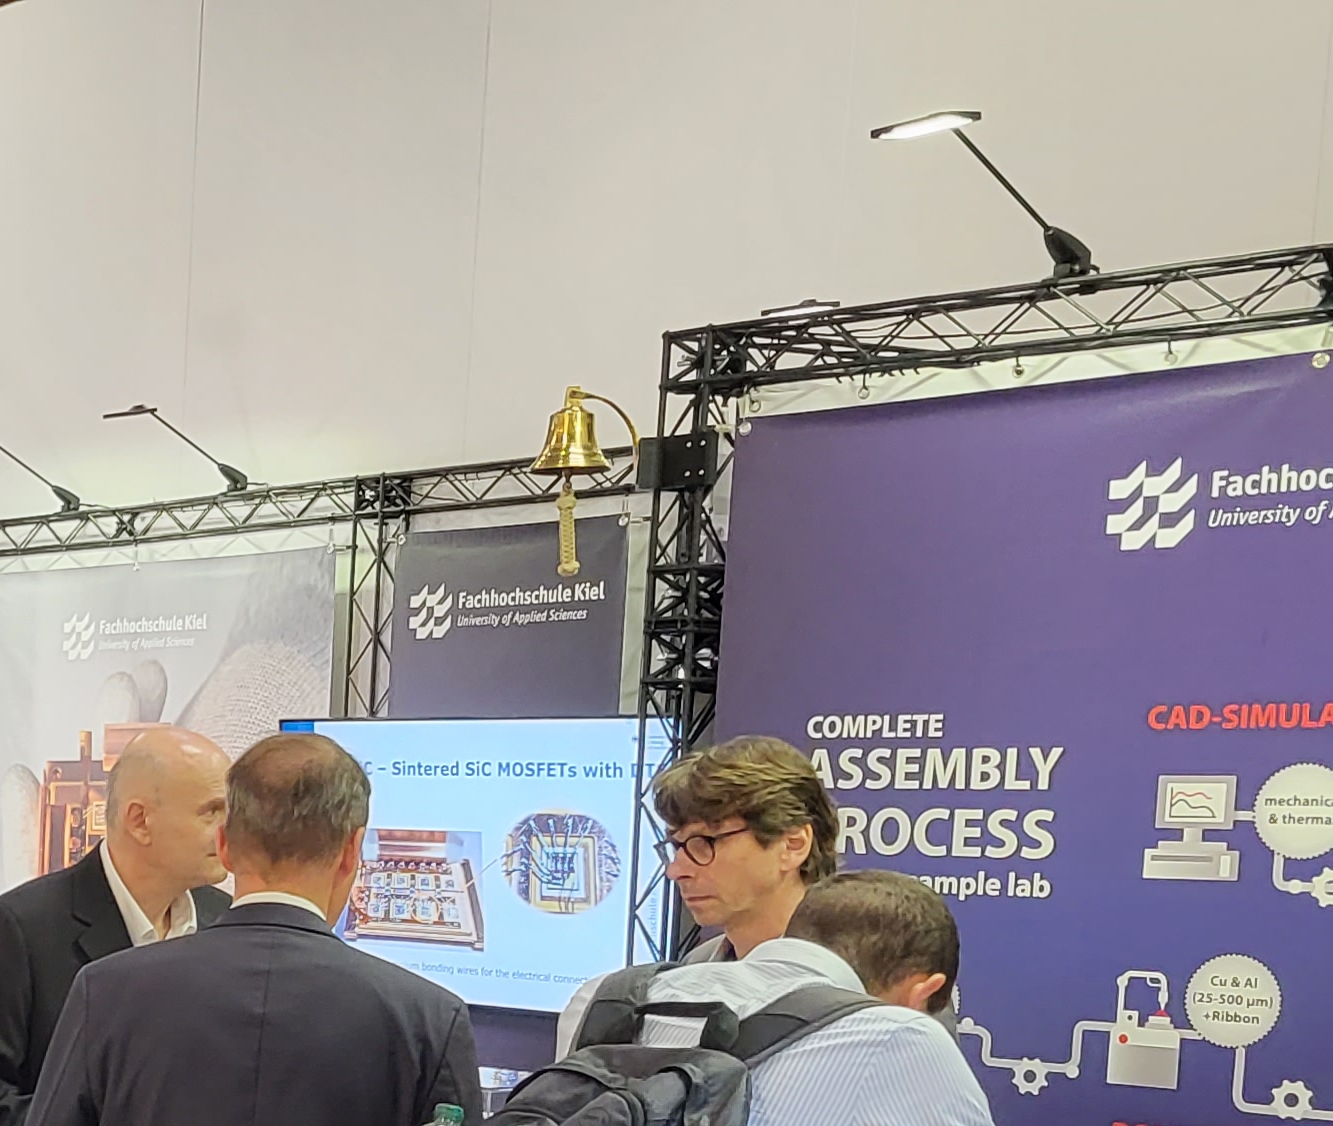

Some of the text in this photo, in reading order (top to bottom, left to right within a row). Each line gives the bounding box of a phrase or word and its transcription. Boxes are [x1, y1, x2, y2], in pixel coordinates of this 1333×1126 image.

[1211, 463, 1333, 498] Fachhoc
[1207, 504, 1301, 527] University
[1304, 499, 1329, 525] of
[458, 580, 605, 609] Fachhochschule Kiel
[99, 612, 207, 635] Fachhochschule Kiel
[456, 608, 588, 628] University of Applied Sciences
[806, 713, 944, 739] COMPLETE
[1147, 702, 1333, 730] CAD-SIMULA
[391, 760, 460, 777] Sintered
[464, 760, 491, 777] SiC
[497, 762, 577, 778] MOSFETs
[582, 761, 623, 778] with
[810, 747, 1064, 790] ASSEMBLY
[1264, 794, 1333, 807] mechanic
[1268, 813, 1278, 825] &
[835, 807, 1056, 860] ROCESS
[1007, 871, 1051, 898] lab
[421, 961, 454, 975] bonding
[495, 968, 509, 979] the
[1210, 975, 1227, 988] Cu
[1230, 976, 1241, 988] &
[1192, 992, 1244, 1006] (25-500
